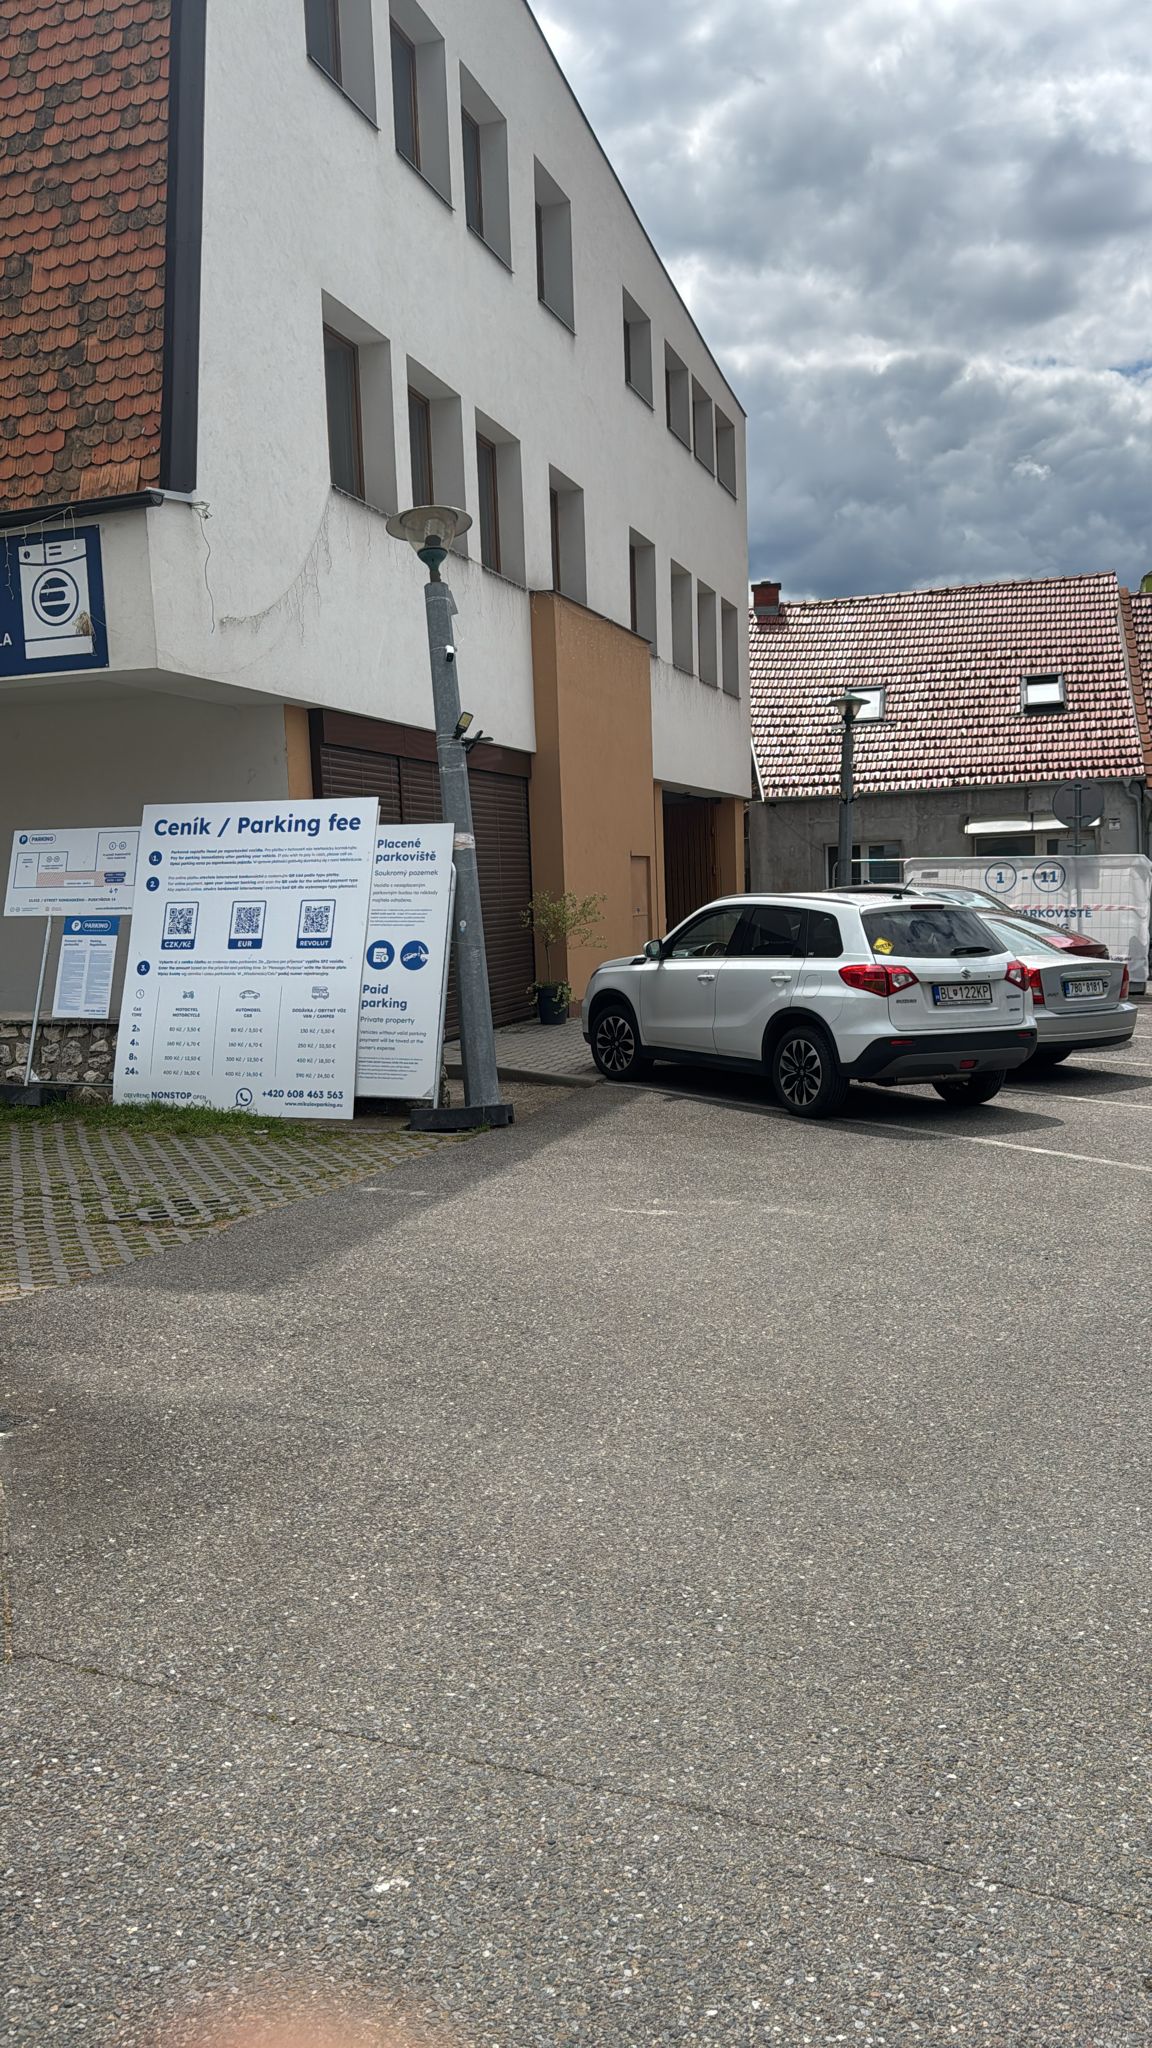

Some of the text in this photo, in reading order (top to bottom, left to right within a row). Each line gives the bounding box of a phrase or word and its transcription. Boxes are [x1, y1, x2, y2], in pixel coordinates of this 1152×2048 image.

[0, 632, 13, 646] A
[154, 813, 361, 837] Ceník / Parking fee
[377, 838, 422, 849] Placené
[375, 851, 437, 864] parkoviště
[408, 869, 438, 877] pozemek
[996, 871, 1005, 884] 1
[1040, 870, 1058, 883] 11
[362, 983, 389, 994] Paid
[941, 985, 989, 999] BL 122KP
[1085, 982, 1101, 991] 8181
[361, 997, 407, 1011] parking
[151, 1091, 192, 1100] NONSTOP
[262, 1089, 344, 1099] +420 608 463 563
